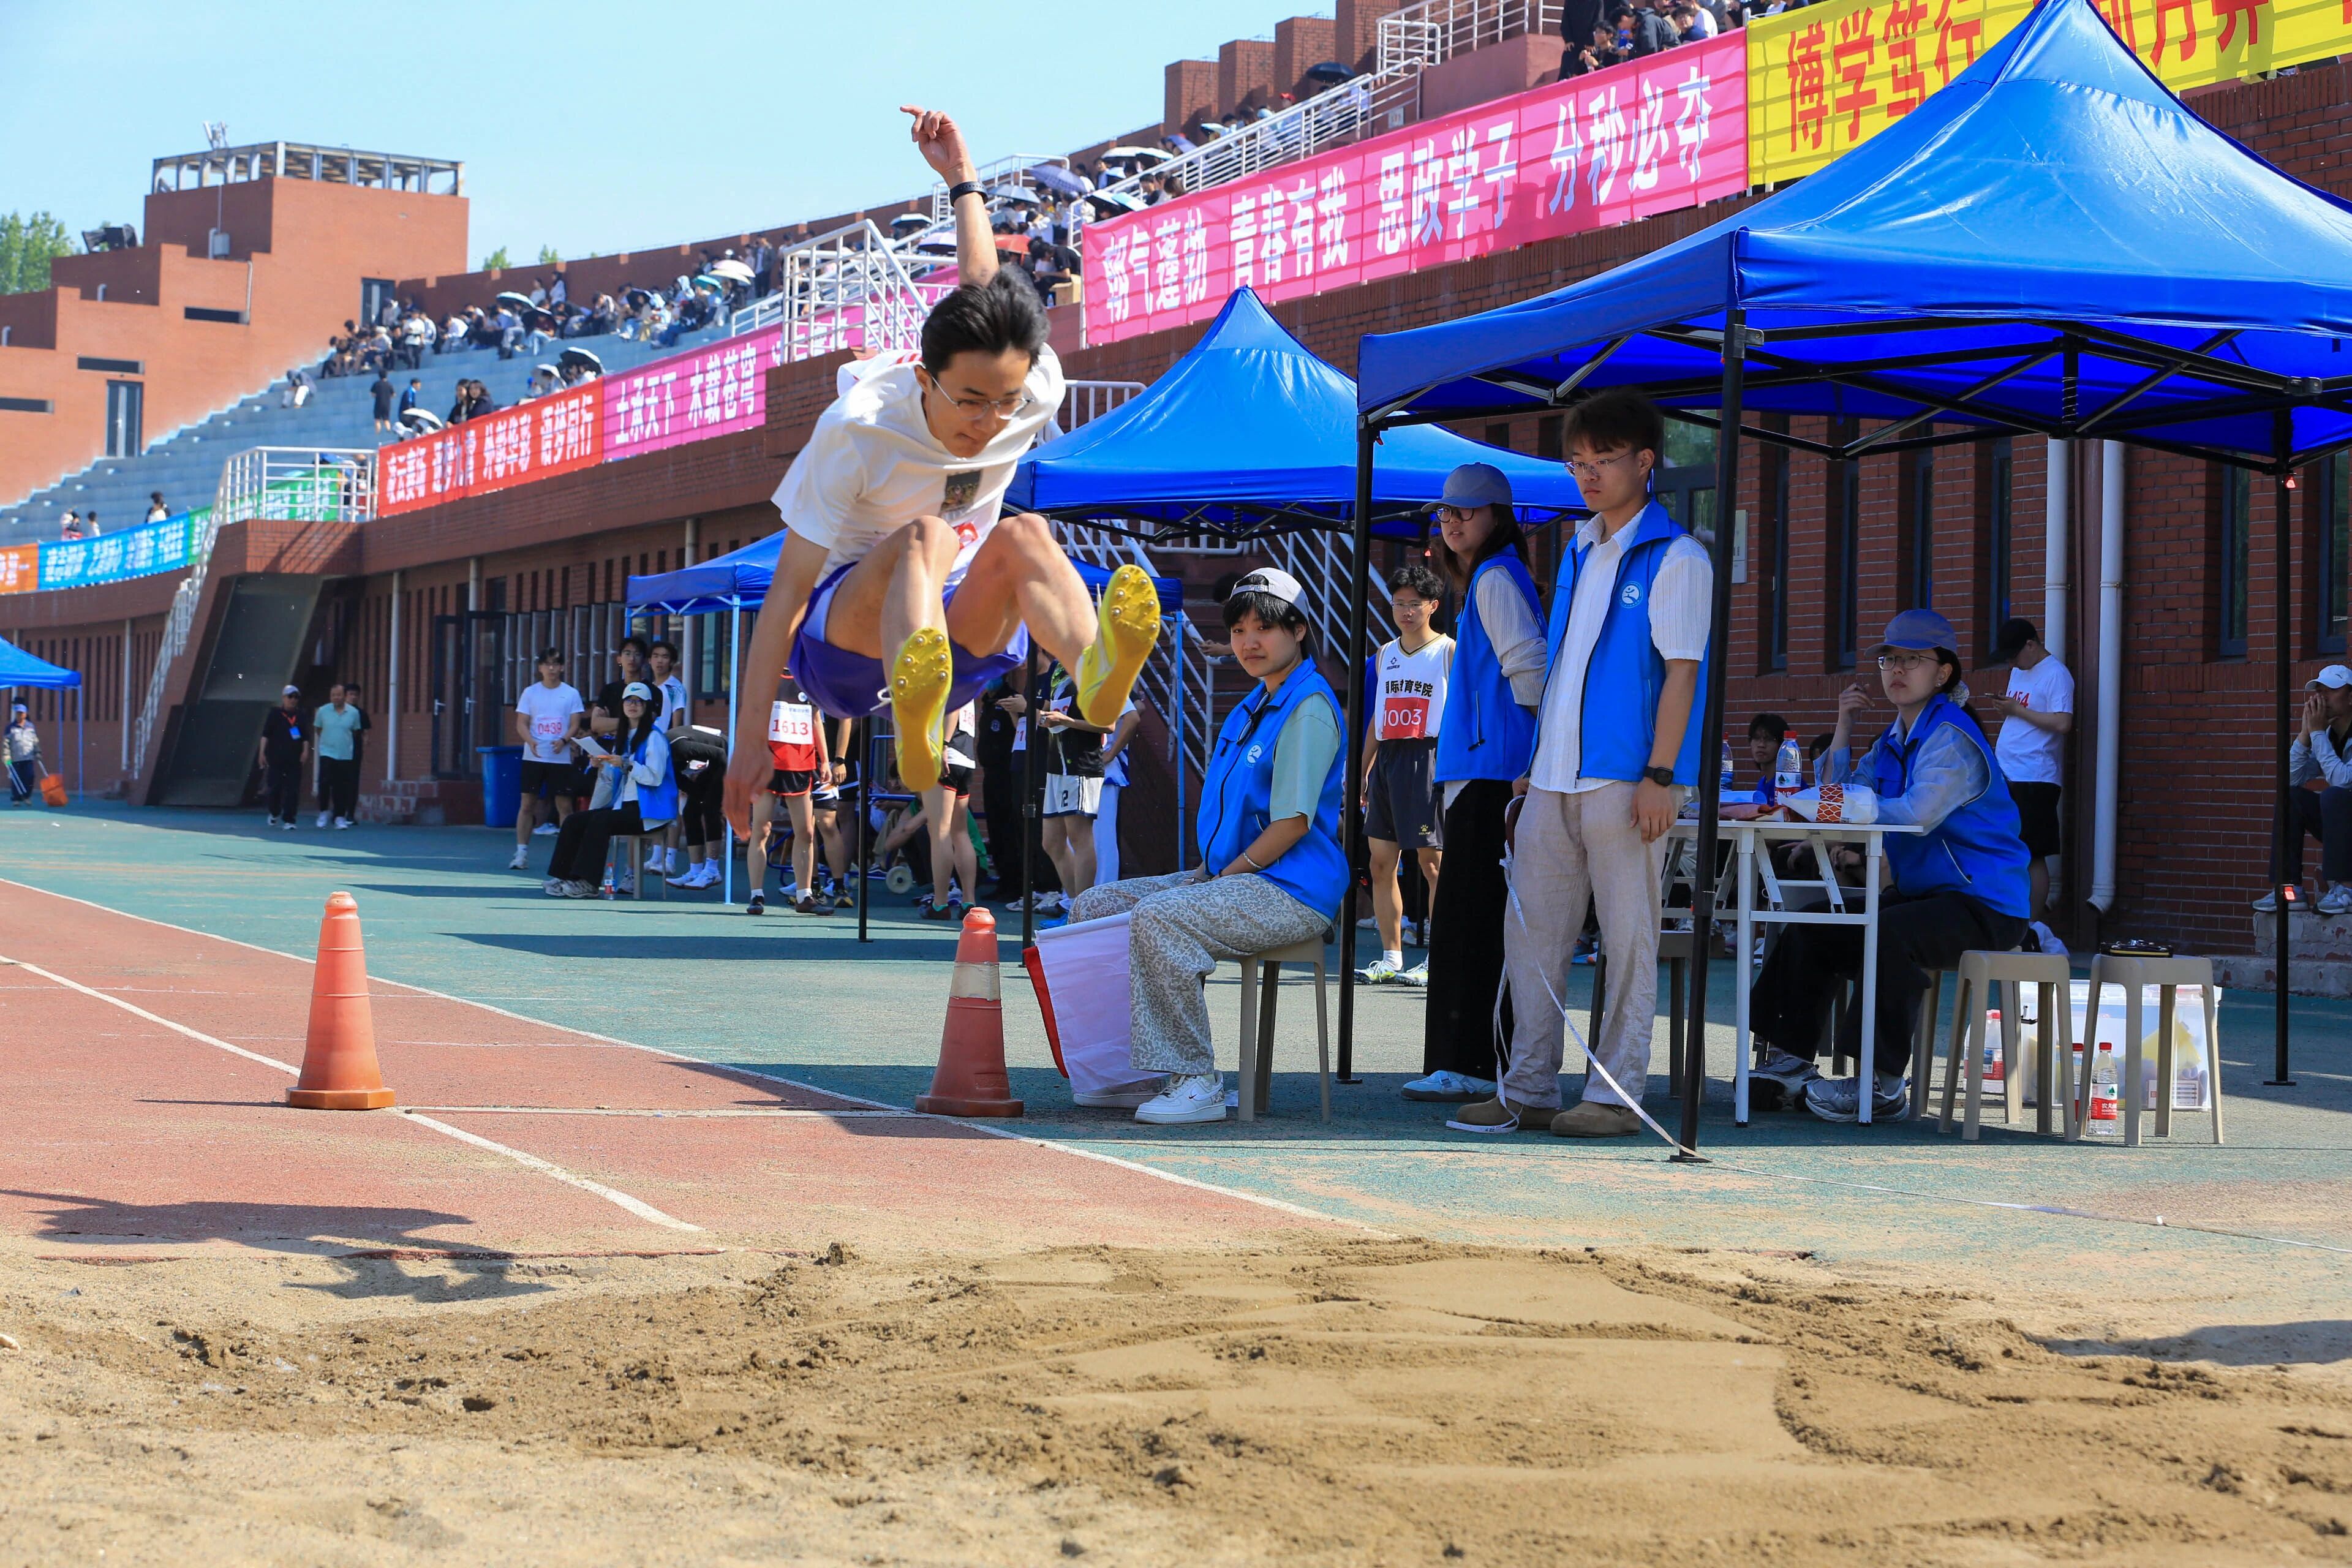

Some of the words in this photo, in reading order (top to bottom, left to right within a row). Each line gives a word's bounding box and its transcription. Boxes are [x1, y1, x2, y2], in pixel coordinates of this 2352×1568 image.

[1102, 207, 1208, 325] 朝气蓬勃
[1229, 166, 1348, 288] 青春有我
[1376, 121, 1517, 255] 思政学子
[1383, 708, 1422, 726] 1003
[772, 718, 809, 736] 1613
